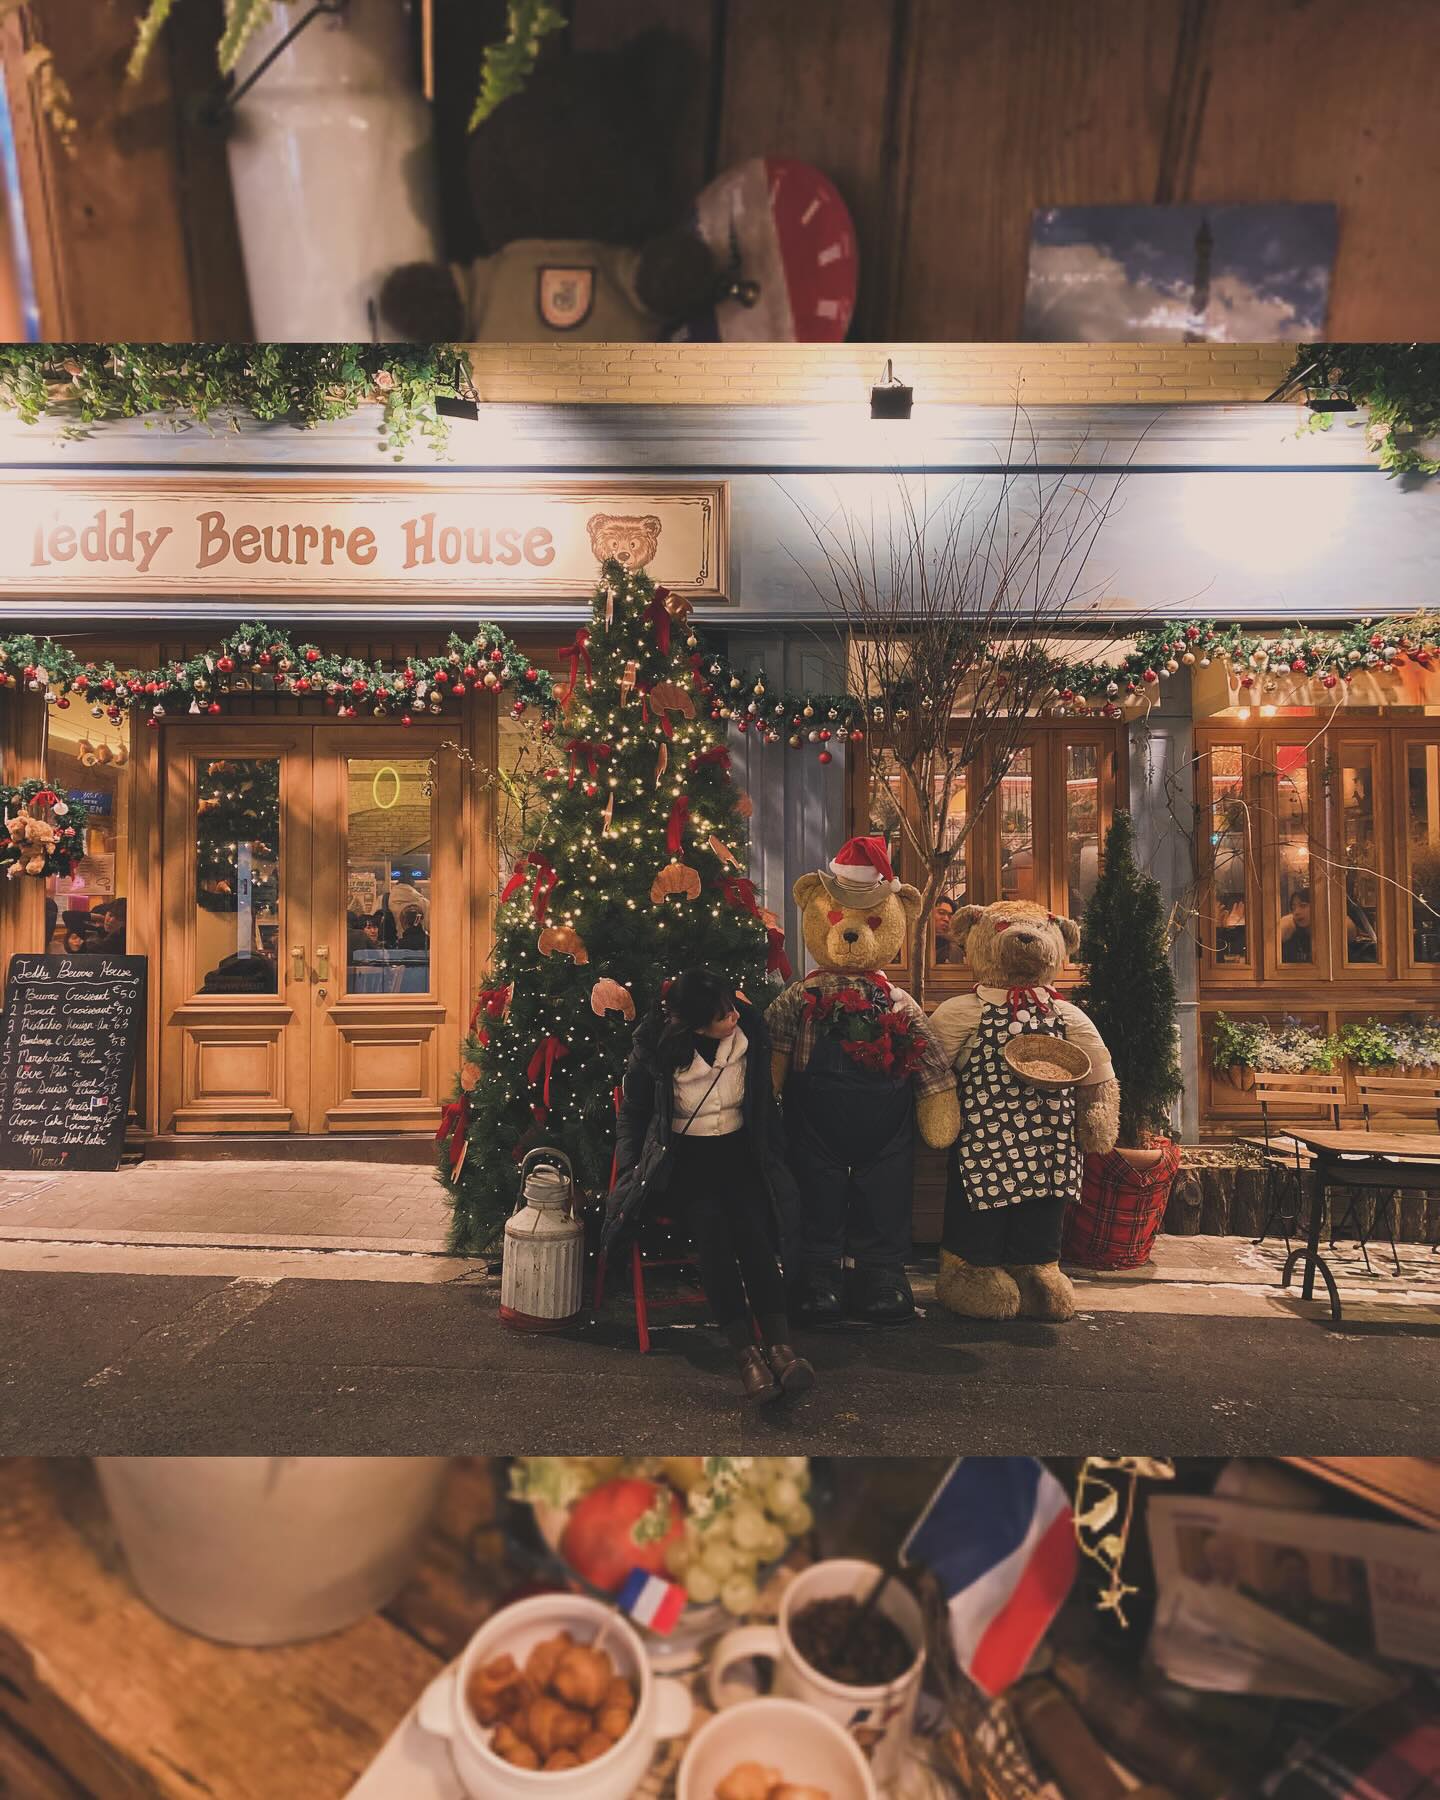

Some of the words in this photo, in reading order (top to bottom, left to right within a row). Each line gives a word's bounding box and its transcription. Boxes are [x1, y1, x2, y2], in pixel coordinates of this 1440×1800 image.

[196, 510, 378, 569] Beurre
[400, 512, 556, 569] House
[16, 960, 50, 980] Teddy
[57, 960, 94, 978] Beurre
[100, 960, 132, 977] House
[13, 990, 19, 1001] 1
[10, 1004, 16, 1016] 2
[24, 1003, 56, 1015] Donut
[8, 1019, 15, 1033] 3
[4, 1036, 10, 1049] 4
[2, 1051, 11, 1065] 5
